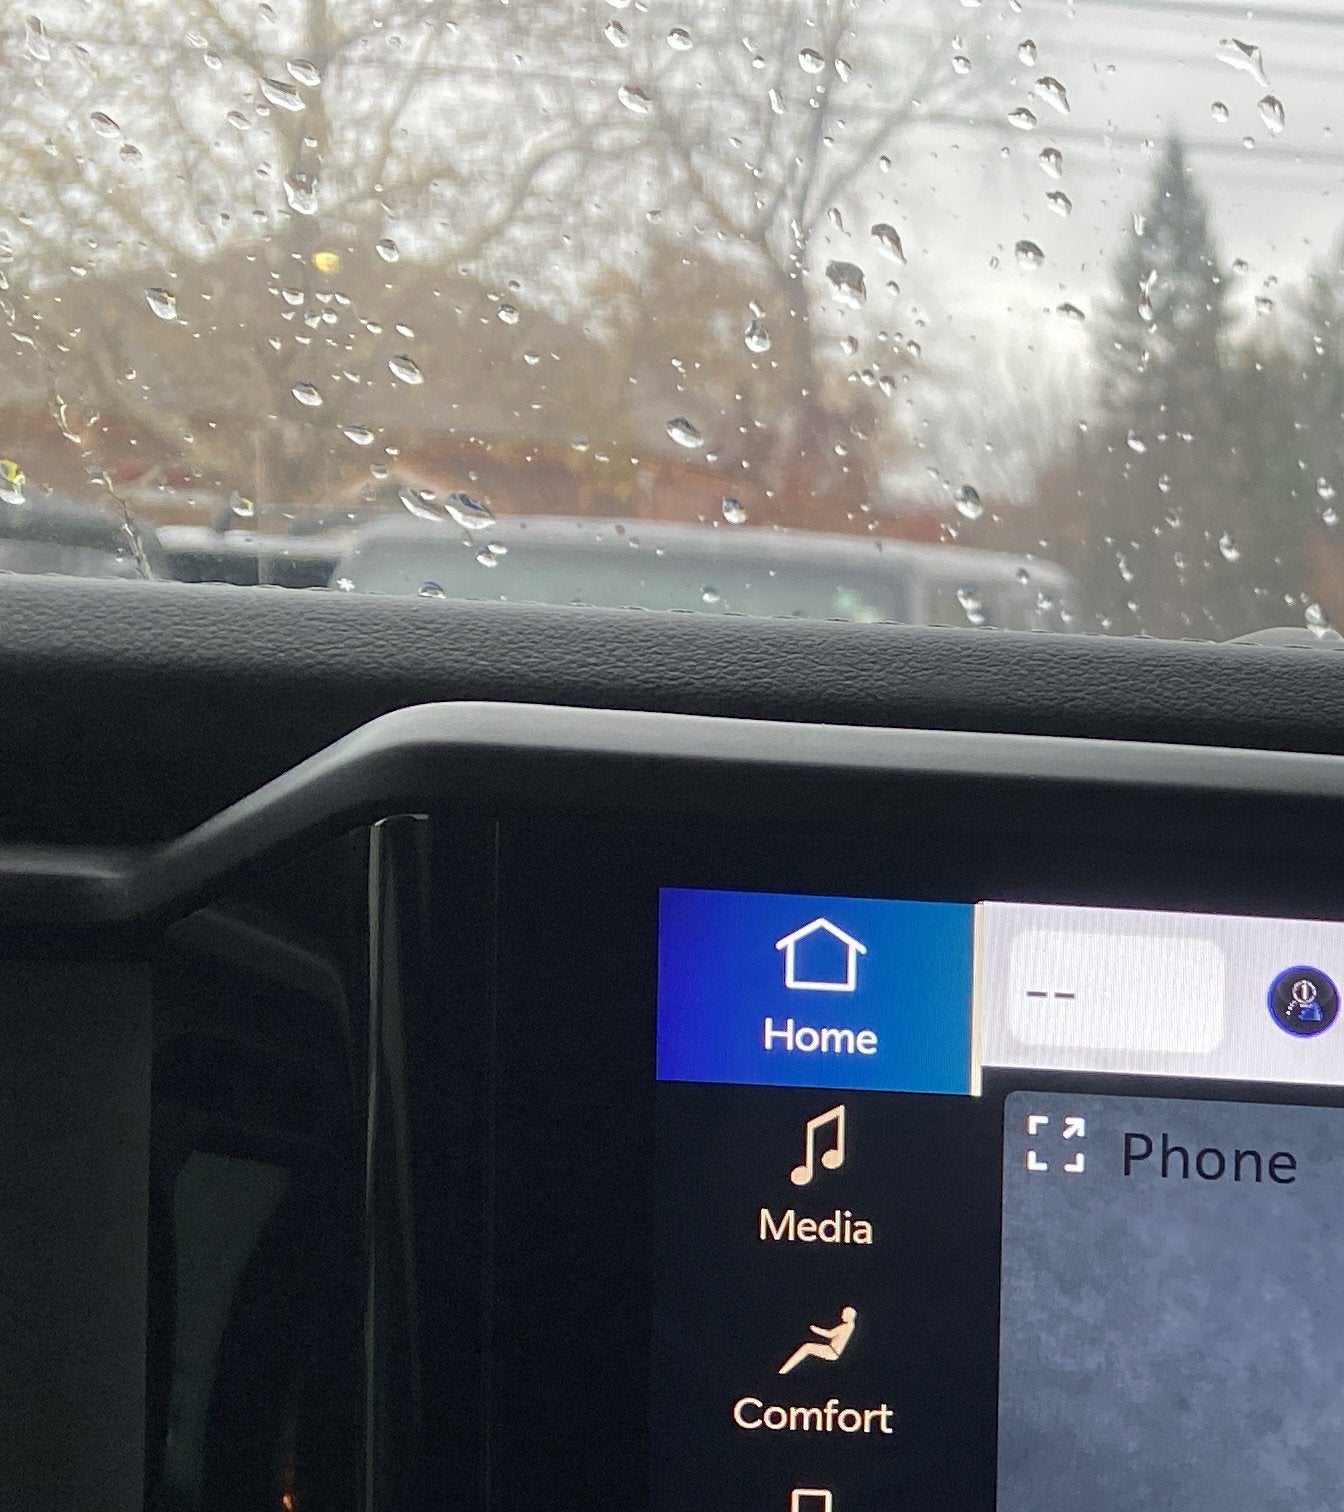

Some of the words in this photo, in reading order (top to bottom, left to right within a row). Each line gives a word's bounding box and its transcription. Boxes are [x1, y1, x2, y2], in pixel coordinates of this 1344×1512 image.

[761, 1017, 879, 1056] Home
[1122, 1131, 1298, 1184] Phone
[758, 1207, 874, 1246] Media
[733, 1396, 894, 1435] Comfort
